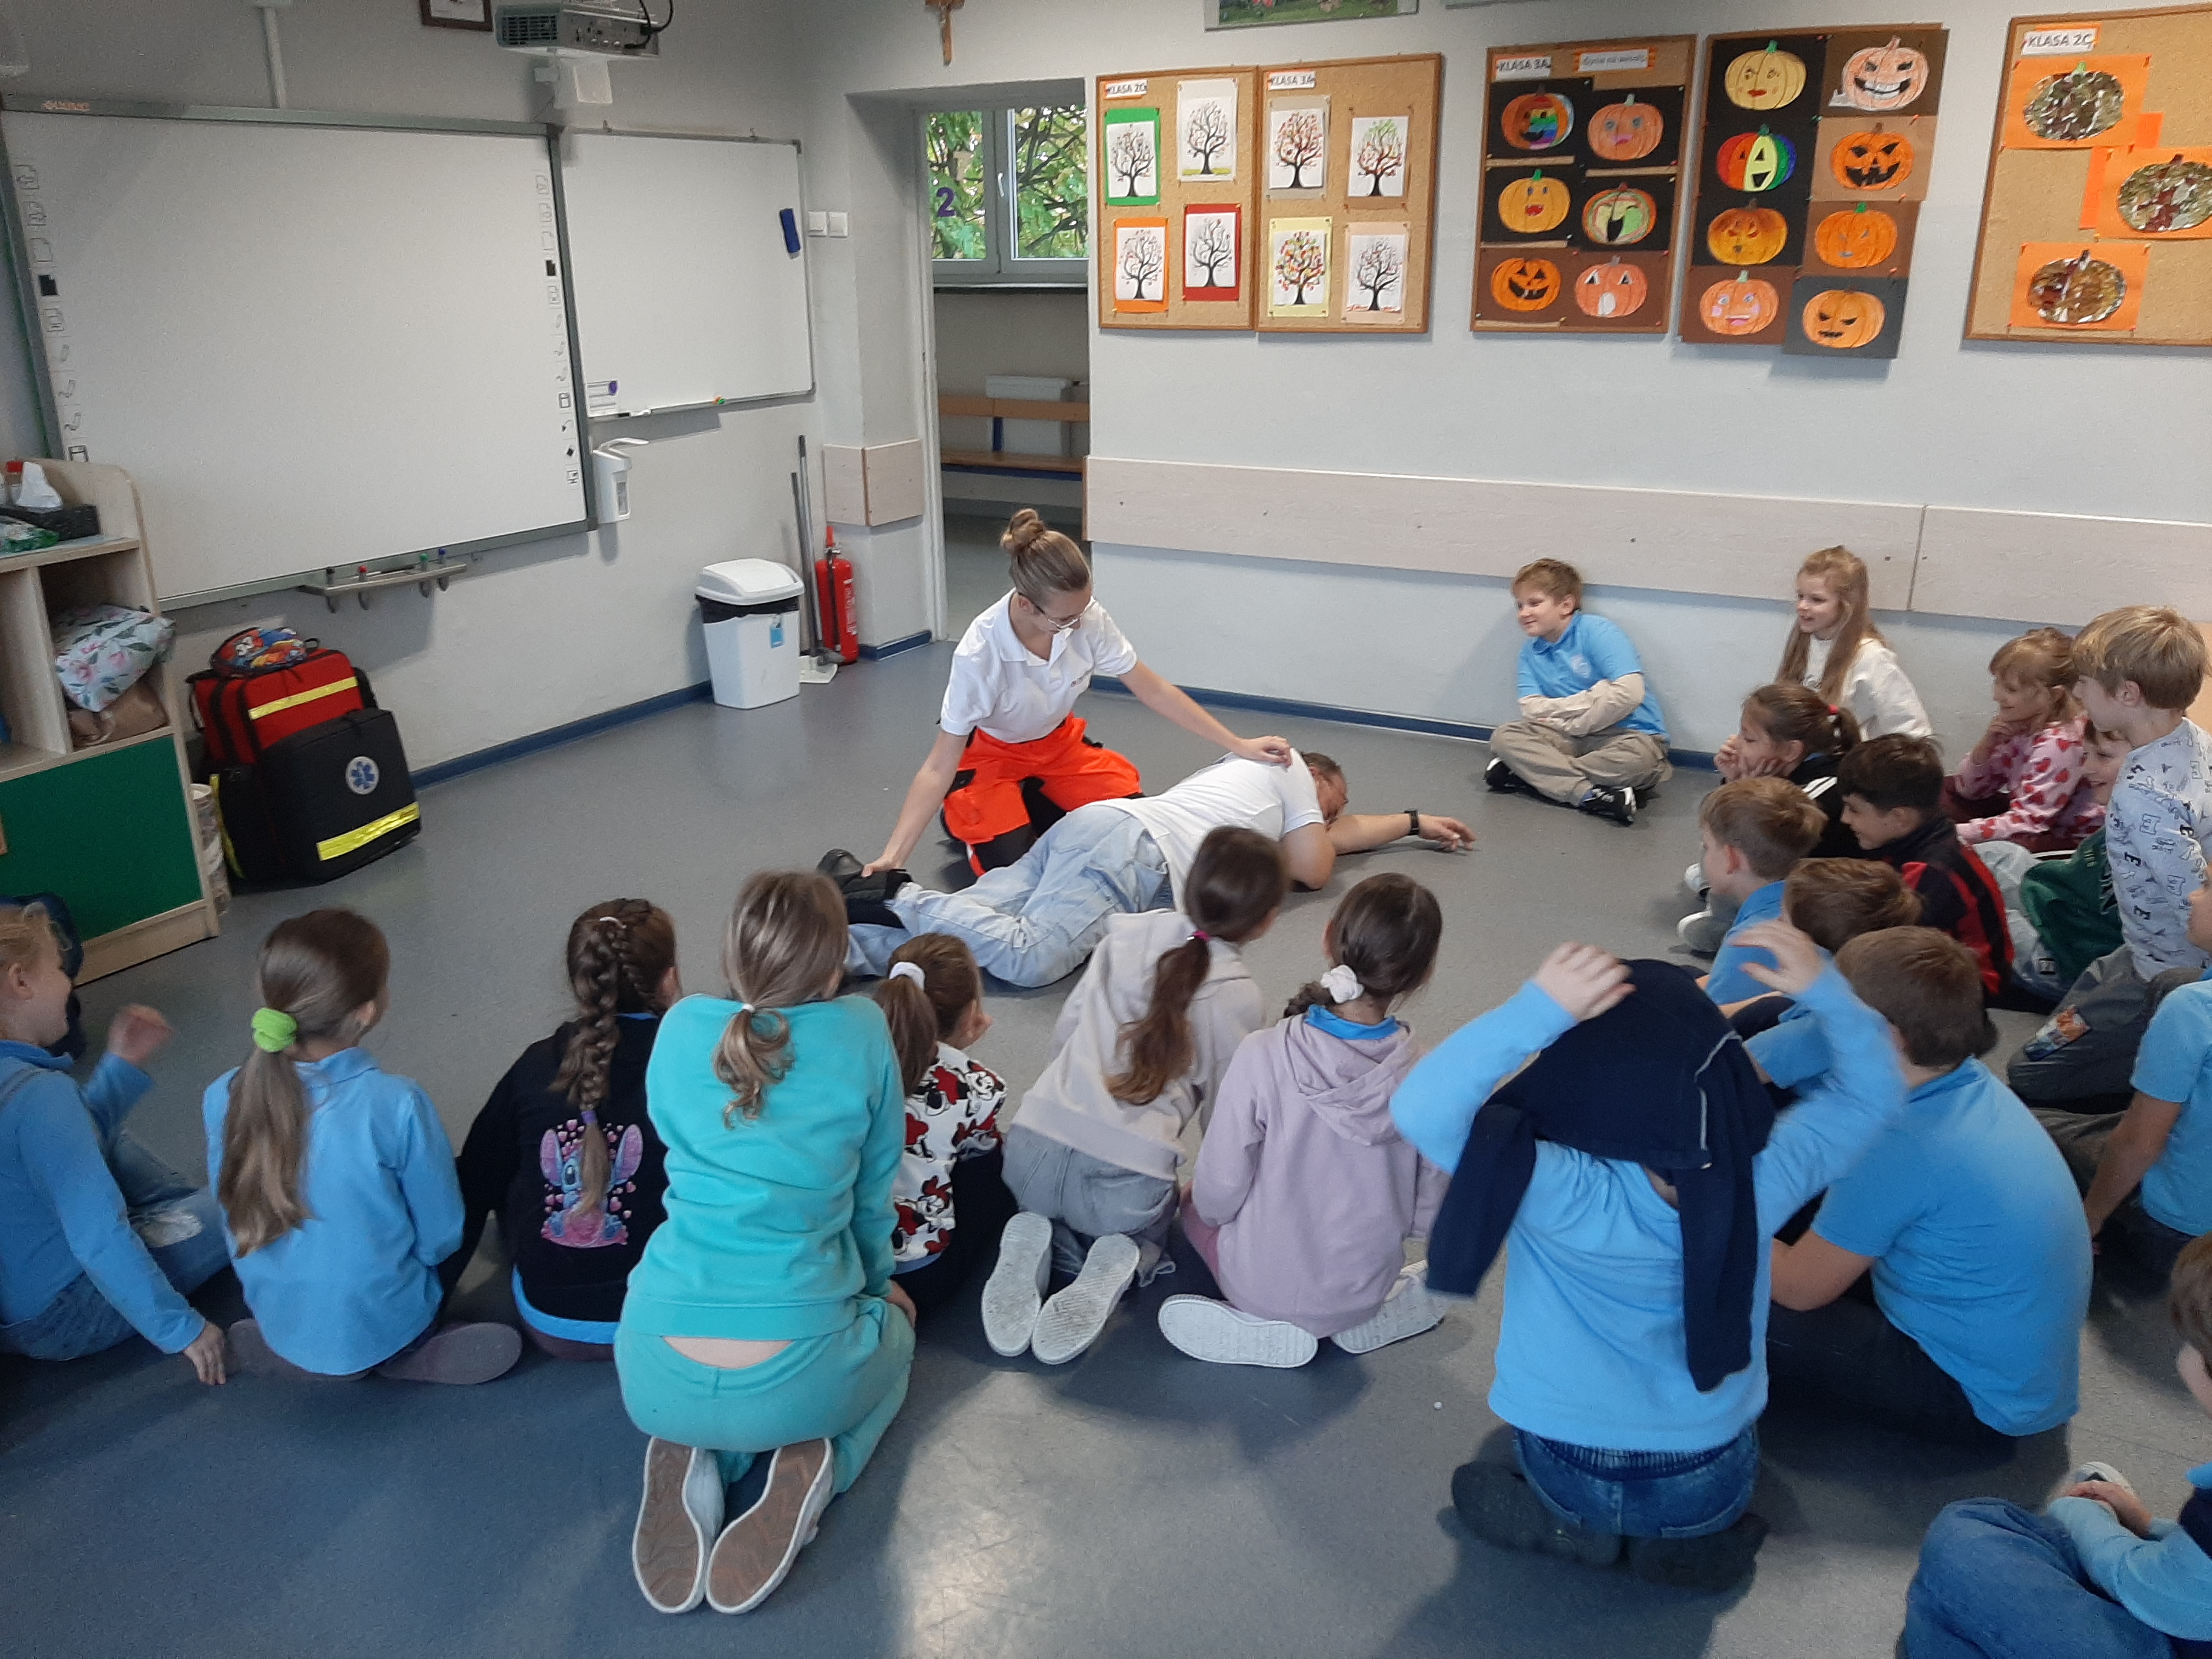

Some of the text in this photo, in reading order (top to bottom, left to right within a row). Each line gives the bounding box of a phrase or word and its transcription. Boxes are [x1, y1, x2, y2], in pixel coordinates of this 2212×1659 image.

[2028, 33, 2092, 47] KLASA 2C
[1498, 59, 1532, 71] KLASA
[1272, 75, 1297, 85] KLASA
[1107, 83, 1132, 94] KLASA
[936, 187, 956, 217] 2
